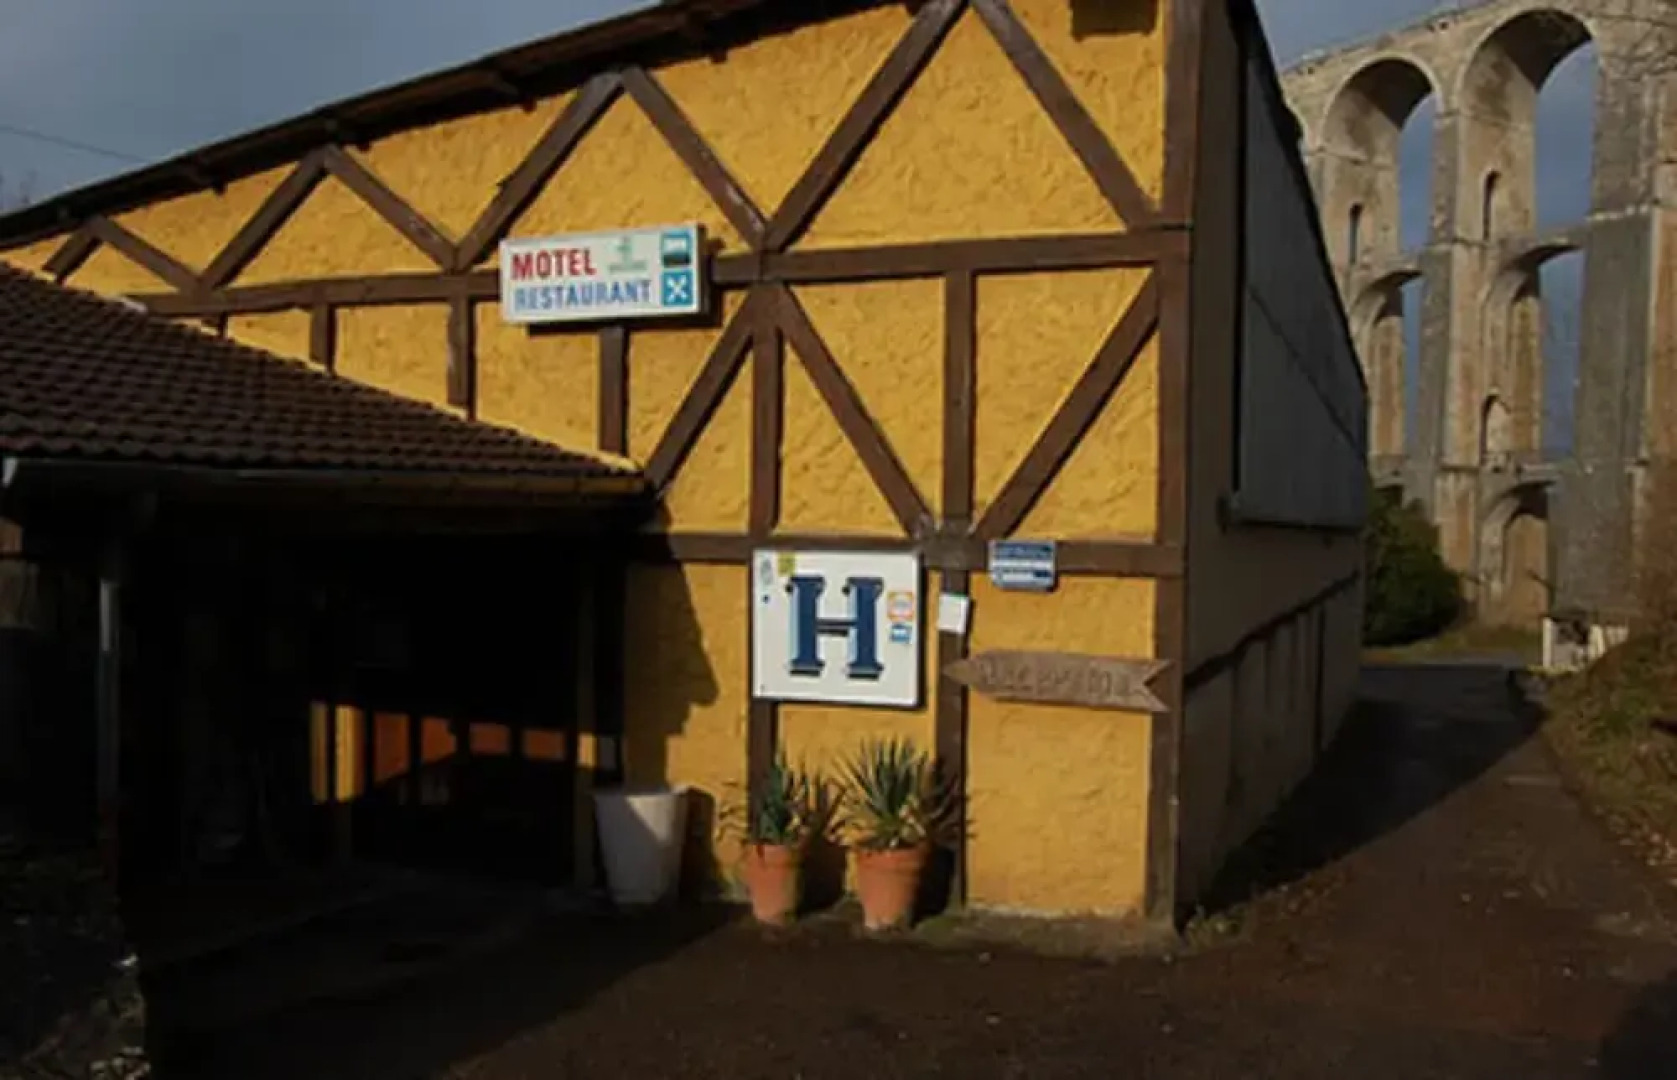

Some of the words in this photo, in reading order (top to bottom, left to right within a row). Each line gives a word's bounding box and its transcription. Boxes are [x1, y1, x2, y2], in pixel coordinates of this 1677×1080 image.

[511, 248, 597, 280] MOTEL
[514, 279, 652, 312] RESTAURANT
[785, 576, 885, 681] H
